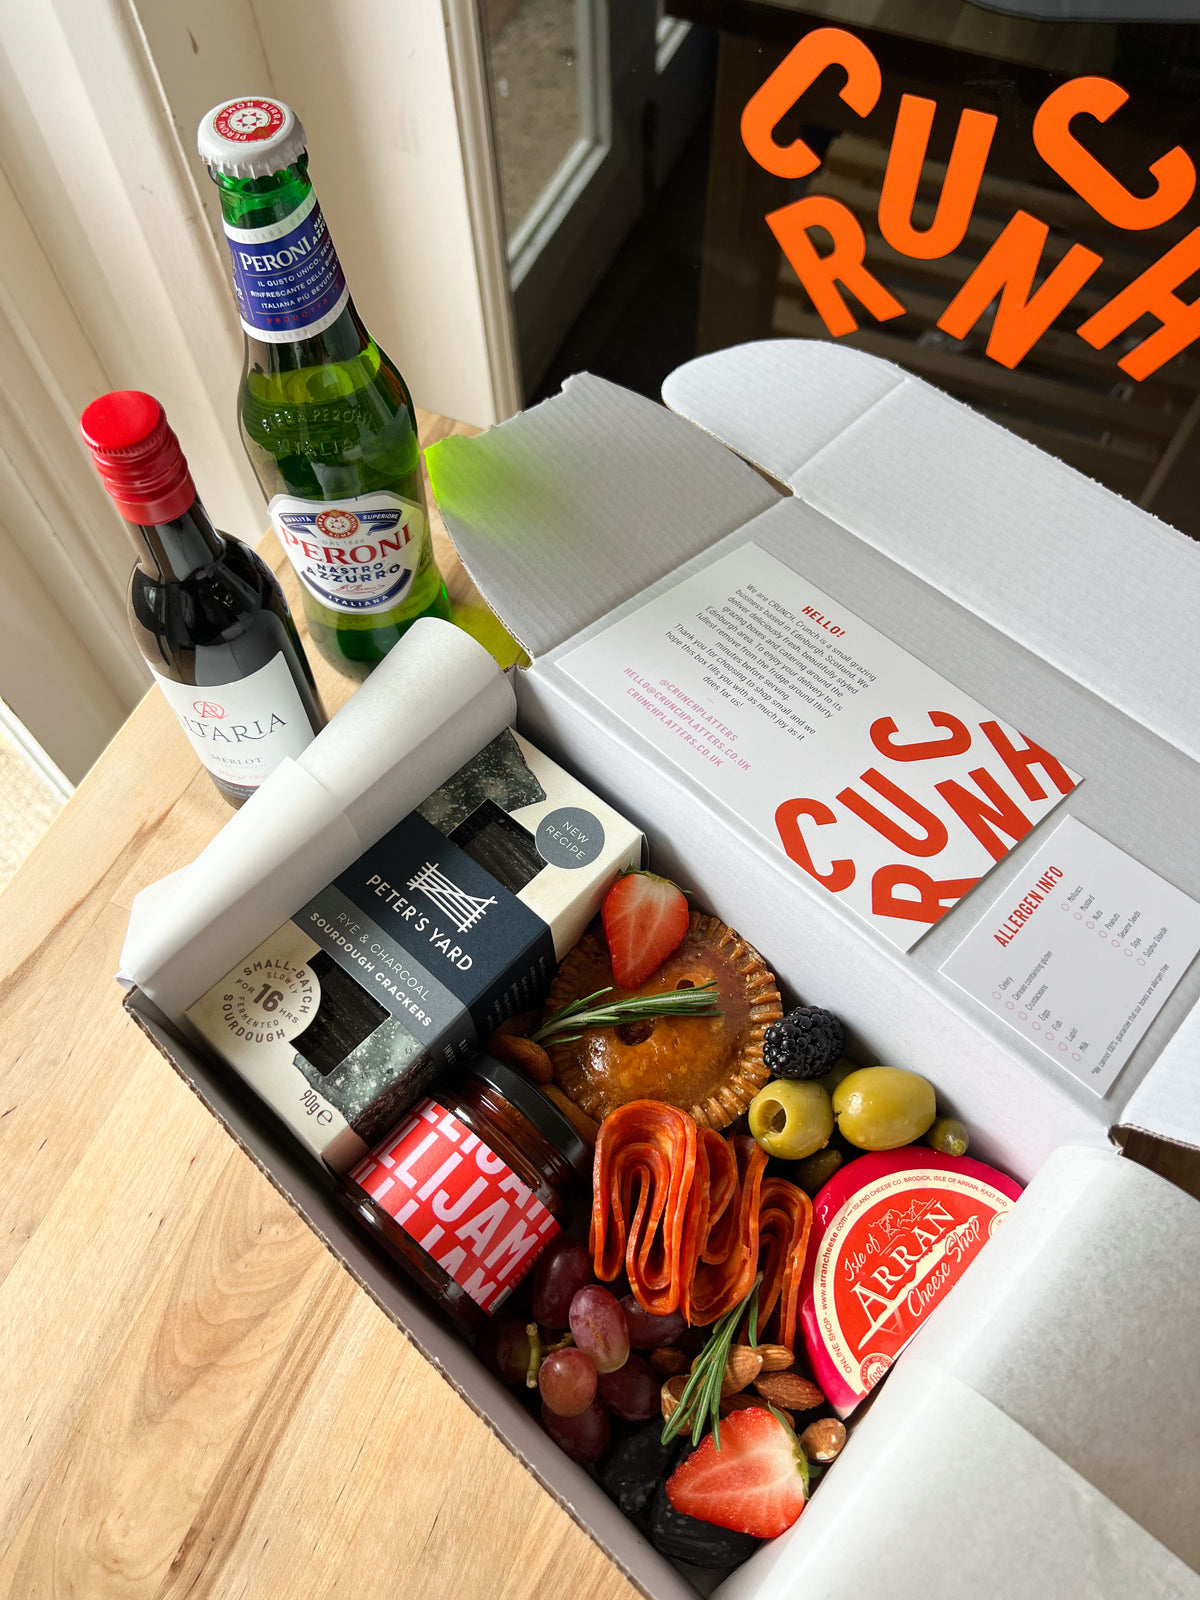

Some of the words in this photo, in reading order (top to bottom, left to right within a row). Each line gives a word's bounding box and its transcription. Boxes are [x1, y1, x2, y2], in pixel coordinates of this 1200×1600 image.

[218, 121, 246, 141] PERONI
[261, 103, 281, 125] BIRRA
[239, 236, 312, 272] PERONI
[261, 300, 295, 309] ITALIANA
[311, 272, 333, 296] BEVUTA
[267, 275, 295, 288] GUSTO
[306, 266, 325, 286] DELLA
[281, 523, 412, 565] PERONI
[307, 563, 400, 584] AZZURRO
[316, 562, 384, 575] NASTRO
[328, 595, 389, 607] ITALIANA
[735, 588, 765, 612] business
[763, 609, 785, 627] based
[783, 624, 792, 632] in
[856, 677, 869, 689] We
[746, 583, 758, 594] We
[756, 592, 769, 602] are
[795, 620, 820, 640] Crunch
[831, 647, 852, 663] small
[849, 659, 877, 682] grazing
[801, 605, 846, 638] HELLO!
[705, 605, 738, 632] Edinburgh
[755, 642, 765, 652] To
[763, 650, 783, 666] enjoy
[780, 663, 799, 677] your
[797, 675, 825, 698] delivery
[823, 695, 833, 704] to
[831, 702, 843, 712] its
[714, 641, 743, 664] minutes
[741, 660, 765, 681] before
[721, 606, 748, 627] grazing
[746, 622, 767, 640] boxes
[765, 637, 781, 650] and
[778, 647, 808, 671] catering
[806, 668, 832, 689] around
[831, 686, 844, 698] the
[727, 596, 750, 614] deliver
[748, 612, 784, 639] deliciously
[801, 650, 838, 679] beautifully
[836, 676, 859, 694] styled
[674, 623, 695, 640] Thank
[692, 638, 708, 651] you
[705, 648, 718, 658] for
[716, 656, 748, 682] choosing
[746, 679, 756, 688] to
[753, 686, 772, 702] shop
[770, 699, 793, 716] small
[789, 713, 806, 727] and
[803, 723, 816, 735] we
[695, 612, 718, 630] fullest
[715, 628, 741, 648] remove
[740, 645, 758, 661] from
[756, 658, 770, 670] the
[767, 667, 790, 686] fridge
[788, 683, 815, 704] around
[812, 701, 833, 719] thirty
[664, 630, 683, 646] hope
[681, 643, 696, 656] this
[693, 653, 709, 666] box
[706, 663, 721, 676] fills
[717, 673, 734, 687] you
[732, 683, 749, 698] with
[747, 695, 758, 705] as
[756, 703, 778, 721] much
[774, 717, 789, 729] joy
[787, 727, 799, 737] as
[797, 732, 806, 741] it
[702, 675, 721, 691] does
[719, 688, 732, 699] for
[730, 697, 745, 708] us!
[624, 667, 752, 771] HELLO@CRUNCHPLATTERS.CO.UK
[626, 687, 724, 767] CRUNCHPLATTERS.CO.UK
[659, 679, 738, 742] @CRUNCHPLATTERS
[211, 754, 263, 765] MERLOT
[545, 825, 586, 860] RECIPE
[562, 821, 589, 843] NEW
[366, 874, 430, 931] PETER'S
[429, 927, 473, 971] YARD
[993, 889, 1045, 948] ALLERGEN
[1035, 865, 1064, 894] INFO
[1103, 912, 1121, 930] Peanuts
[1117, 922, 1133, 939] Sesame
[310, 912, 376, 973] SOURDOUGH
[375, 972, 432, 1027] CRACKERS
[336, 912, 361, 935] RYE
[359, 934, 370, 945] &
[370, 943, 431, 1002] CHARCOAL
[243, 959, 313, 1014] SMALL-BATCH
[267, 971, 298, 994] SLOWLY
[998, 976, 1015, 991] Celery
[1011, 983, 1028, 1001] Cereals
[1024, 983, 1049, 1011] Crustaceans
[222, 994, 285, 1043] SOURDOUGH
[236, 978, 255, 994] FOR
[253, 983, 284, 1012] 16
[279, 1008, 299, 1024] HRS
[237, 996, 279, 1029] FERMENTED
[1038, 1008, 1051, 1021] Eggs
[1051, 1020, 1064, 1032] Fish
[852, 1194, 871, 1211] ISLAND
[869, 1181, 892, 1197] CHEESE
[947, 1176, 957, 1184] OF
[979, 1187, 996, 1199] KA27
[819, 1215, 849, 1311] www.arrancheese.com
[844, 1251, 867, 1281] Isle
[866, 1233, 881, 1254] of
[850, 1200, 955, 1323] ARRAN
[908, 1262, 950, 1317] Cheese
[944, 1217, 981, 1263] Shop
[823, 1317, 836, 1342] SHOP
[831, 1342, 853, 1374] ONLINE
